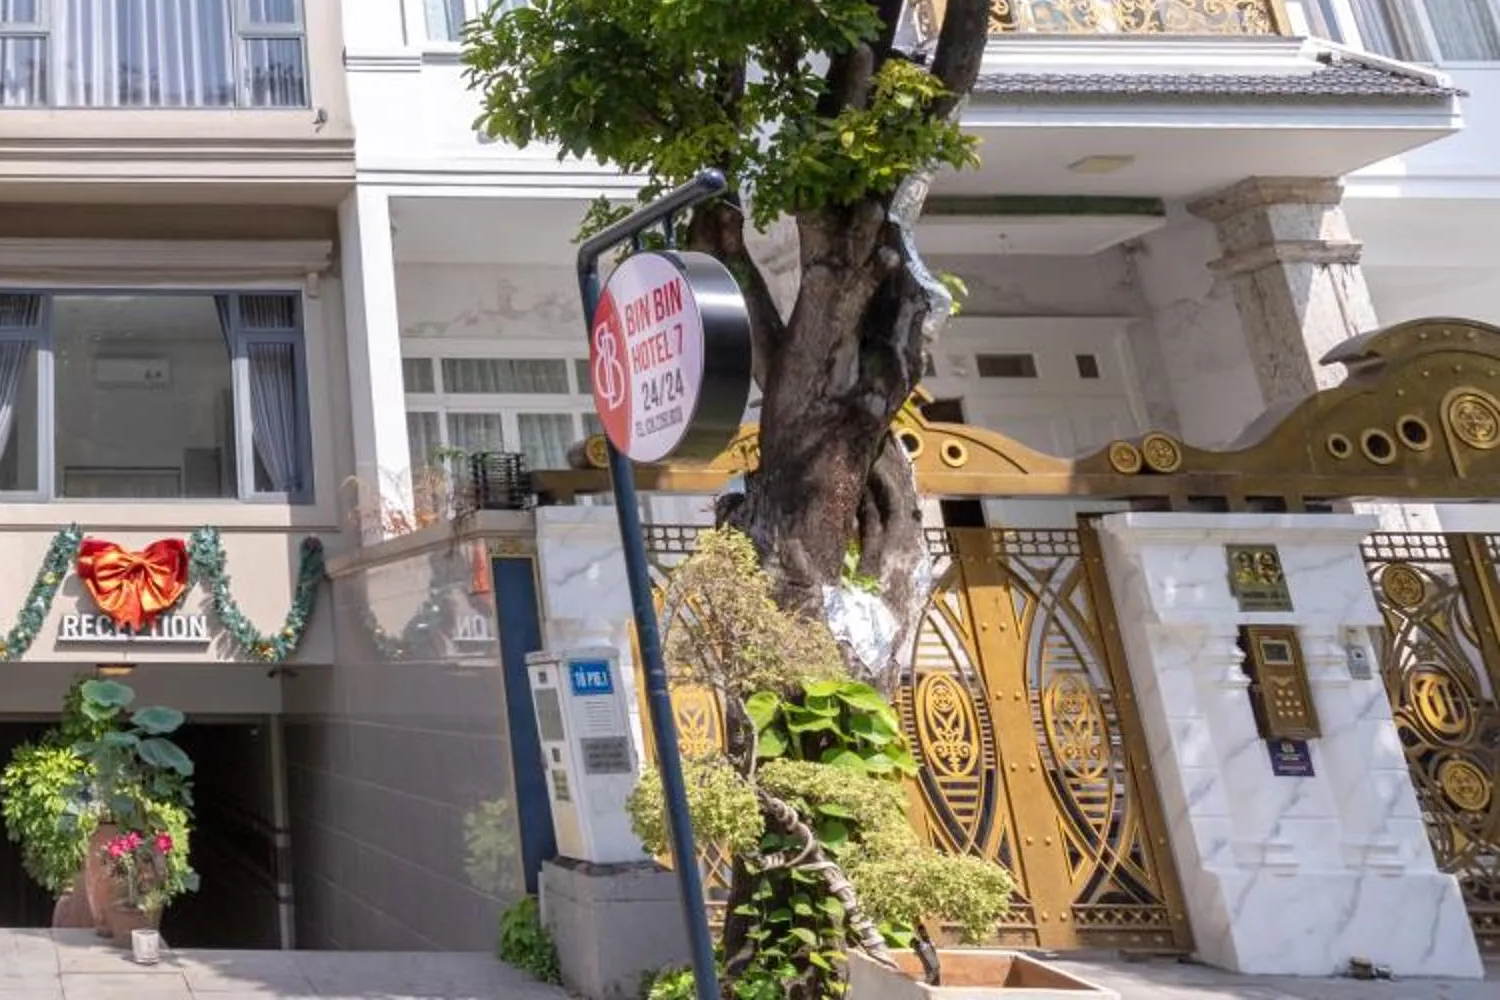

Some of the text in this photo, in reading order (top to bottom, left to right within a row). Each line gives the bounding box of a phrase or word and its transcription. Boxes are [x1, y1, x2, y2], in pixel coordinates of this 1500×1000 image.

[625, 277, 682, 336] BIN BIN
[631, 322, 683, 373] HOTEL 7
[641, 368, 684, 410] 24/24
